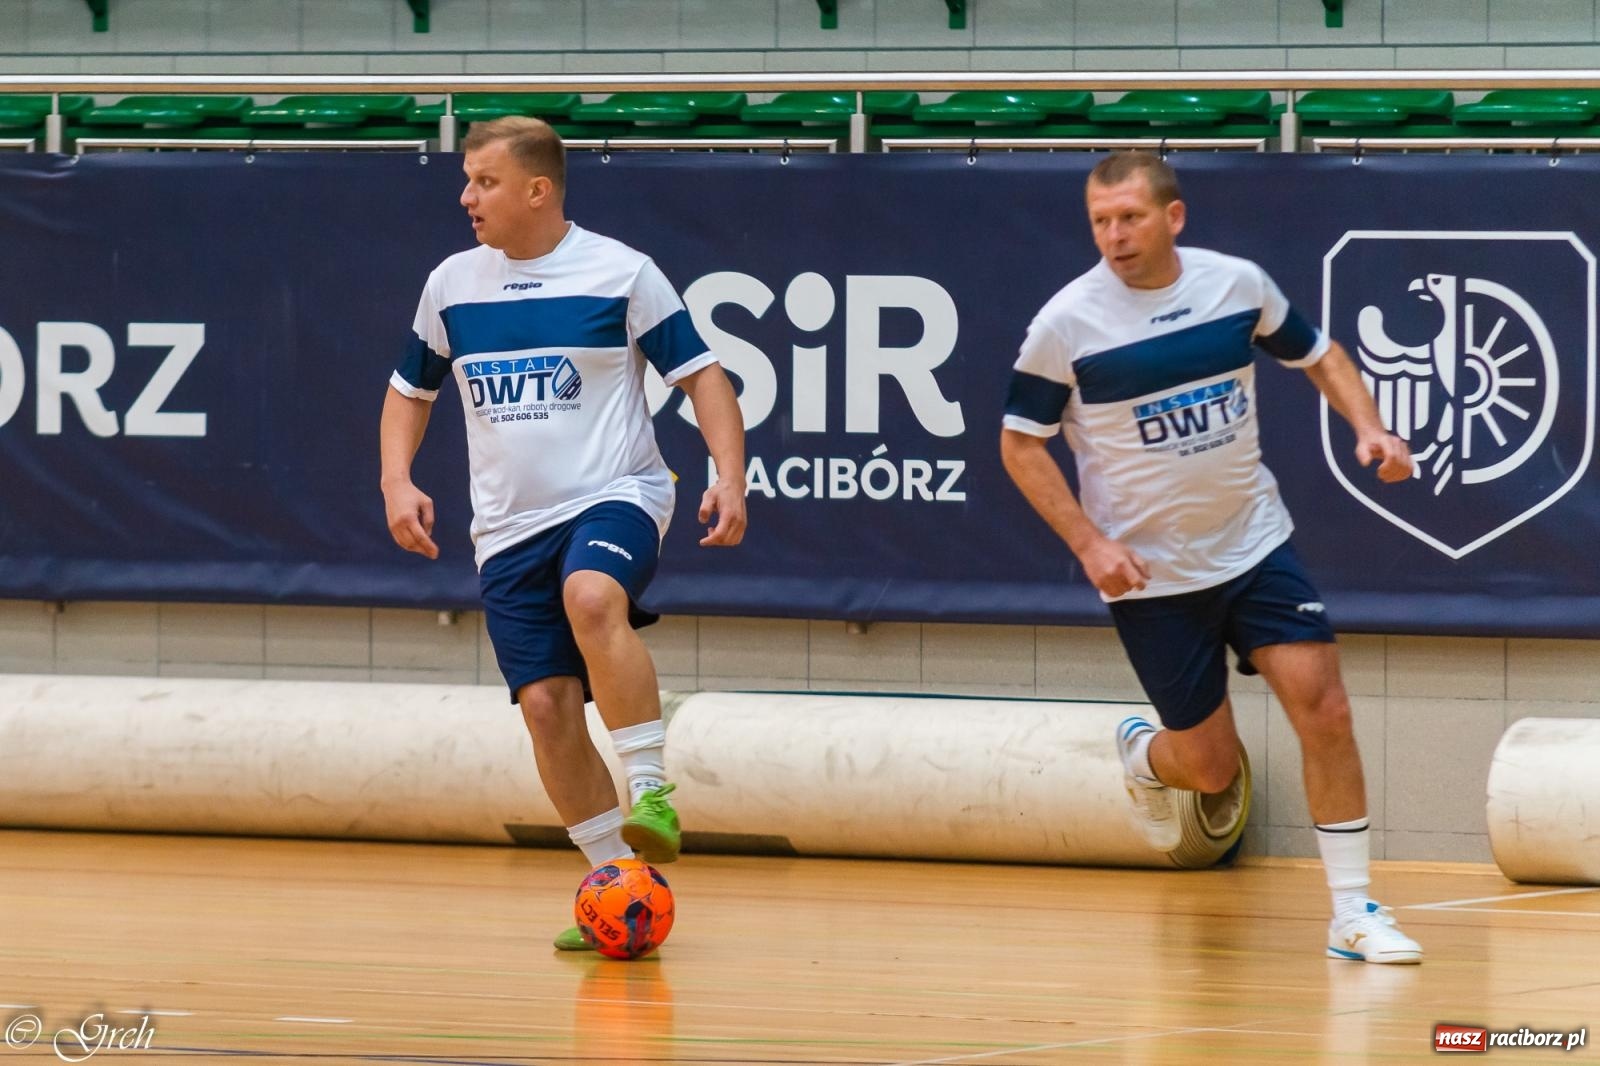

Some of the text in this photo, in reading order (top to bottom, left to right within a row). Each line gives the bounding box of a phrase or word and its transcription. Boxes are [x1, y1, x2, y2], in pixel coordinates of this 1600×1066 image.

[503, 282, 543, 291] regio
[644, 271, 966, 437] SiR
[468, 372, 554, 408] DWT
[501, 413, 515, 422] 502
[516, 411, 532, 421] 606
[533, 412, 549, 420] 535
[1136, 396, 1230, 446] DWT
